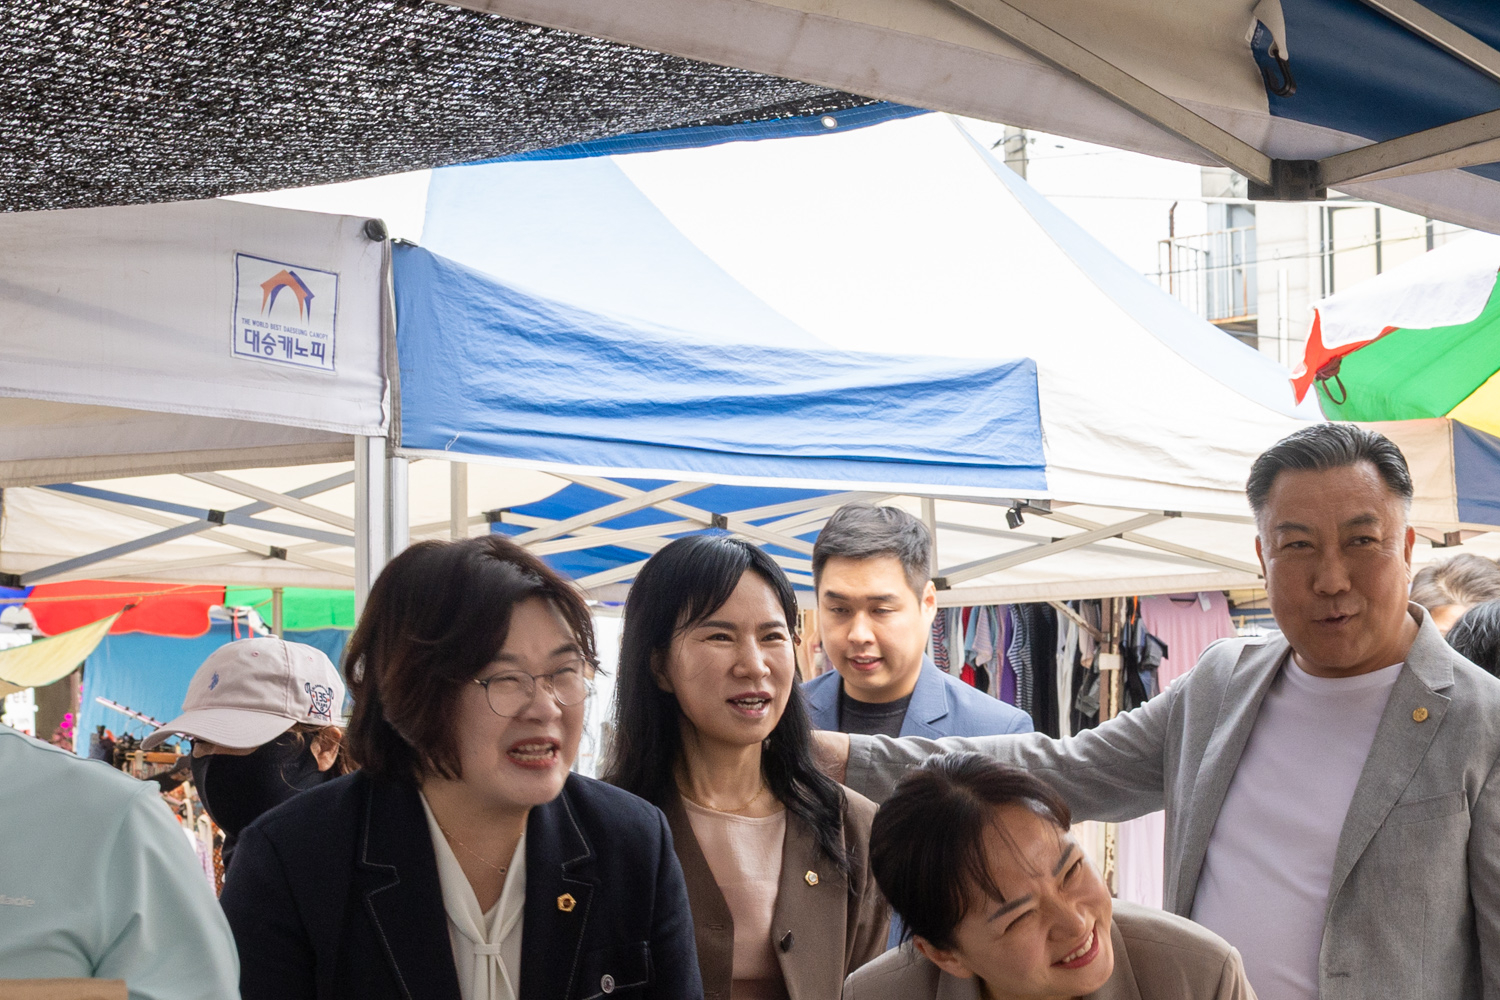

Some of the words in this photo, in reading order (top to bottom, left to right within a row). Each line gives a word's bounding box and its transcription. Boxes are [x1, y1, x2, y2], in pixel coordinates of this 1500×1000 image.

[241, 317, 251, 326] THE
[252, 319, 269, 329] WORLD
[270, 323, 282, 332] BEST
[309, 331, 329, 341] CANOPY
[244, 328, 326, 365] 대승캐노피
